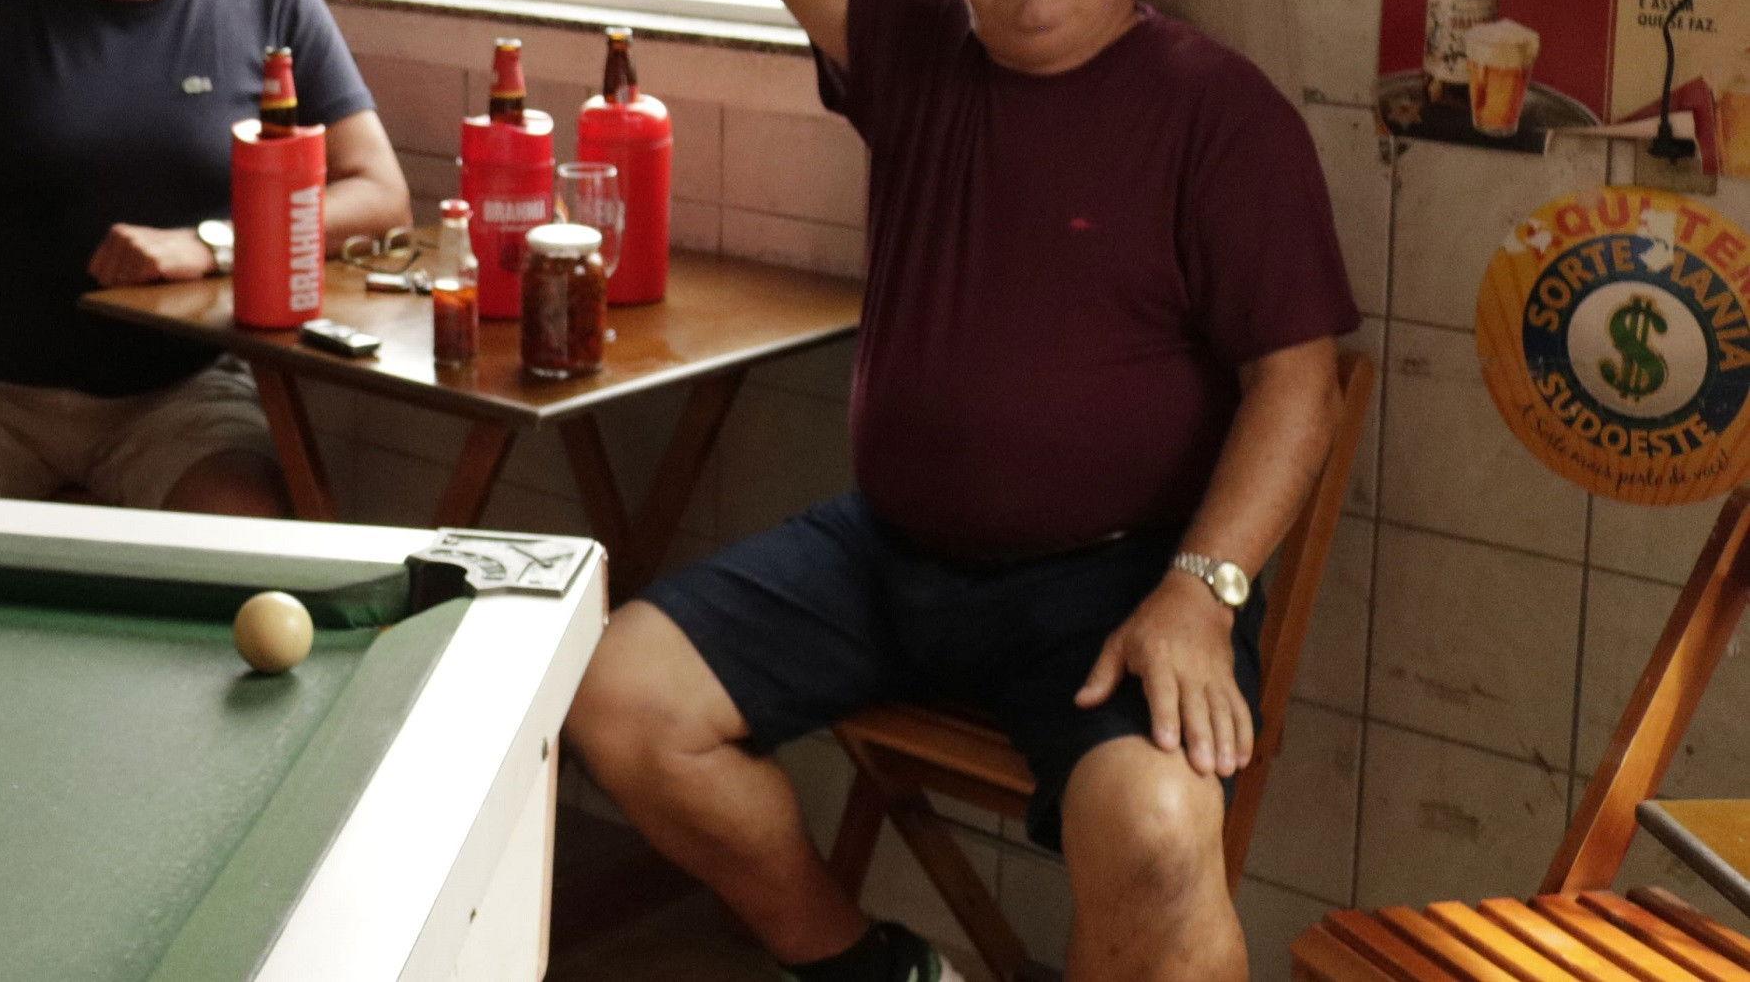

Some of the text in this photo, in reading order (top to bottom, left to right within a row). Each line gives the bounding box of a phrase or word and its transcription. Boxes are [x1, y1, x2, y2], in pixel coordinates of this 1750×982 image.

[290, 185, 322, 312] BRAHMA
[1528, 237, 1635, 332] SORTE
[1539, 371, 1718, 459] SUDOESTE
